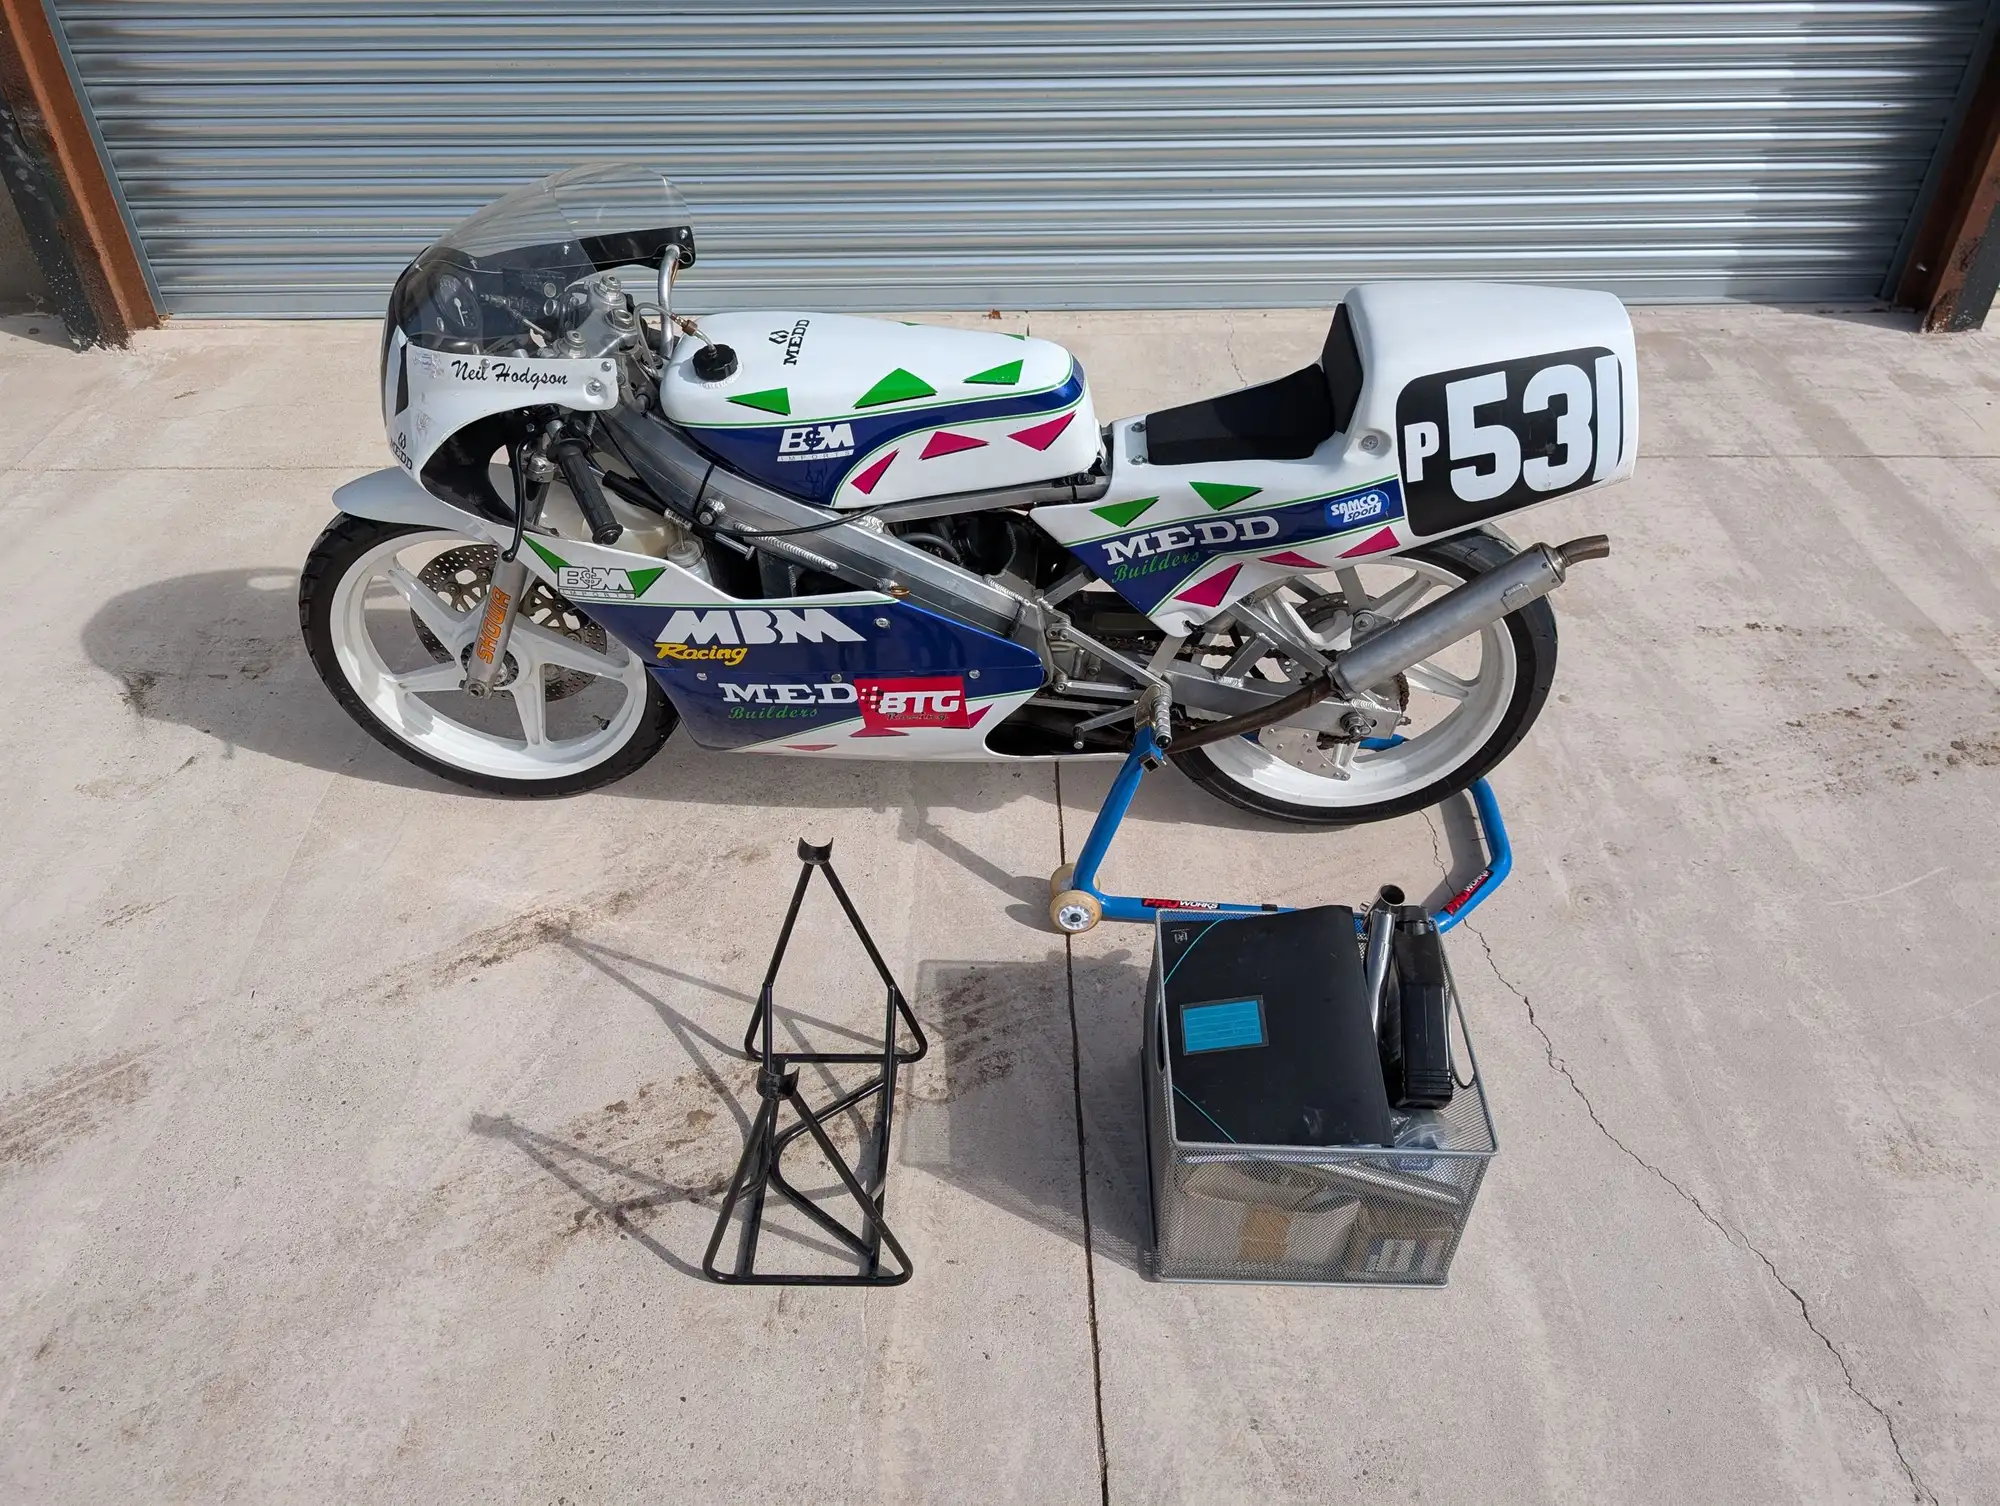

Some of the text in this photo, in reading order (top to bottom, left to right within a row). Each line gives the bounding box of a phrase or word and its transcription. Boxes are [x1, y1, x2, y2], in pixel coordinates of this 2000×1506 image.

[783, 319, 810, 366] MEDD
[451, 360, 568, 390] Neil Hodgson
[779, 423, 855, 452] B&M
[1330, 493, 1379, 516] SAMCO
[1347, 504, 1378, 521] sport
[1102, 515, 1279, 565] MEDD
[557, 566, 635, 592] B&M
[1112, 549, 1199, 584] Builders
[476, 586, 511, 664] SHOWA
[655, 608, 867, 644] MBM
[654, 643, 748, 666] Racing
[728, 704, 818, 719] Builders
[878, 690, 961, 714] BTG
